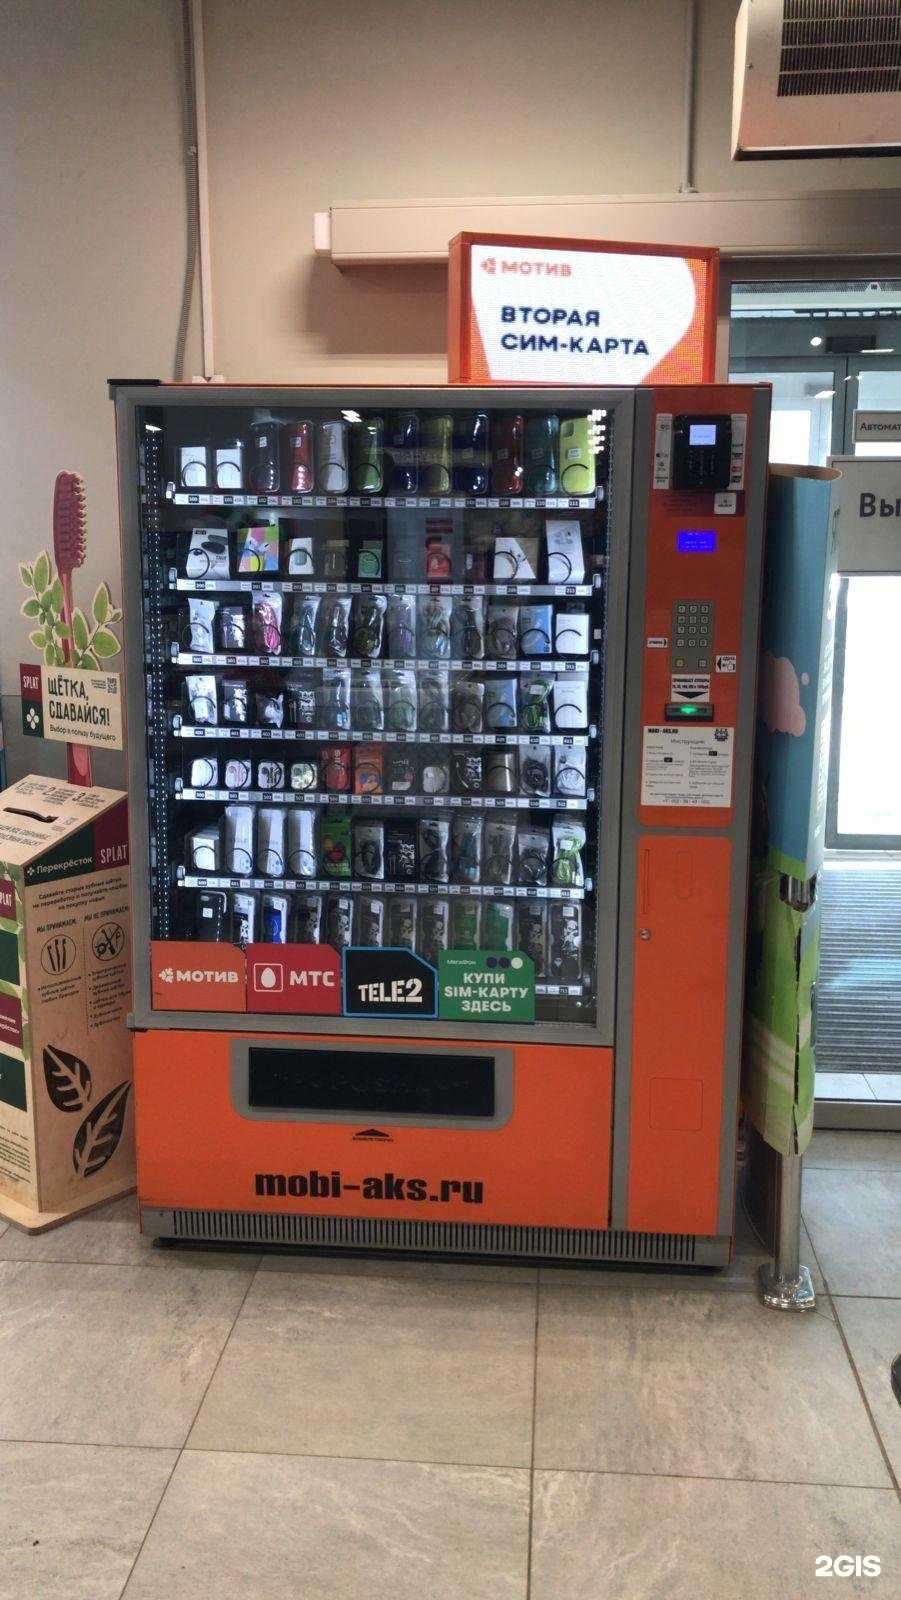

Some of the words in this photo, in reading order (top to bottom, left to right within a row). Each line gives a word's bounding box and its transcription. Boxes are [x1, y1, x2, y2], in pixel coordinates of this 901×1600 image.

[501, 260, 572, 278] МОТИВ
[501, 306, 600, 328] ВТОРАЯ
[501, 333, 650, 357] СИМ-КАРТА
[23, 675, 39, 690] SPLAT
[48, 675, 89, 701] ЩЁТКА,
[49, 700, 110, 726] СДАВАЙСЯ!
[49, 724, 67, 735] Выбор
[89, 731, 116, 742] будущего
[100, 845, 128, 864] SPLAT
[37, 857, 94, 875] Перекрёсток
[176, 969, 239, 984] МОТИВ
[289, 970, 335, 987] МТС
[463, 972, 505, 984] КУПИ
[358, 977, 423, 1003] TELE2
[444, 985, 529, 998] SIM-КАРТУ
[461, 999, 512, 1013] ЗДЕСЬ
[255, 1170, 484, 1204] mobi-aks.ru
